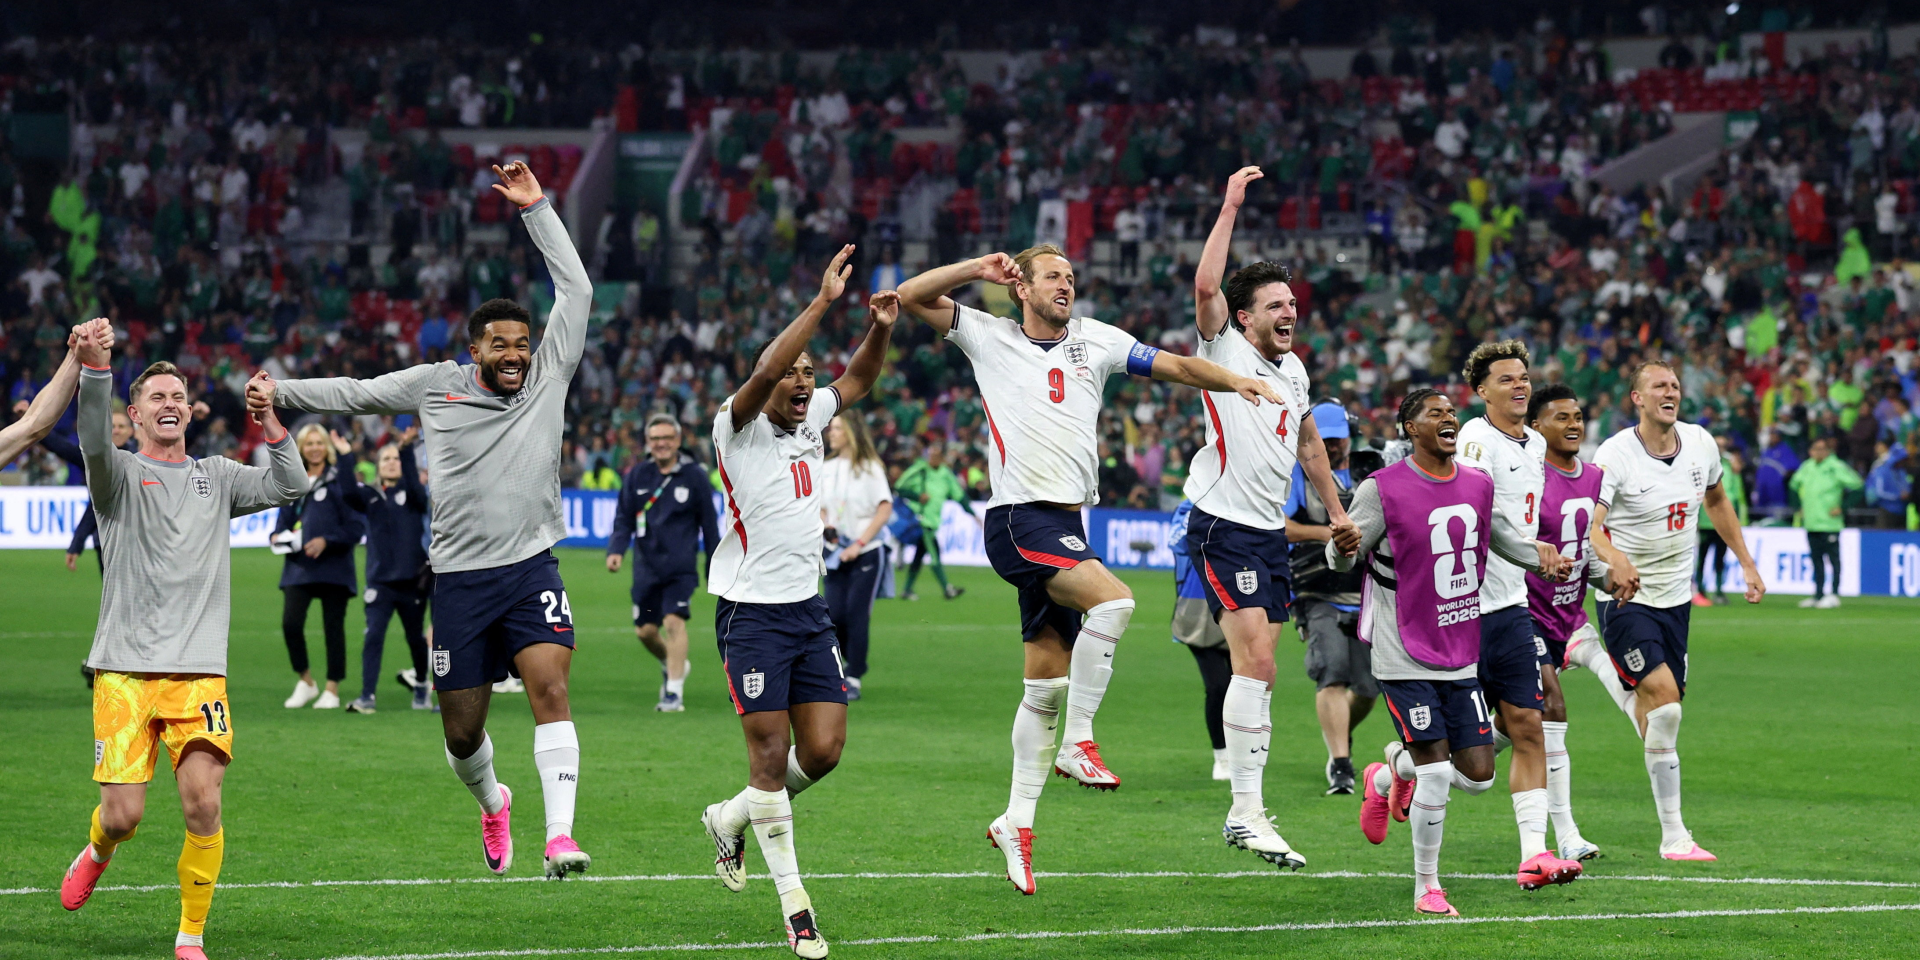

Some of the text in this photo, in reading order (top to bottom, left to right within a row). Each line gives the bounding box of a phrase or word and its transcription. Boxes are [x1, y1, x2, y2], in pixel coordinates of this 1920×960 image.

[1048, 367, 1065, 404] 9
[1276, 409, 1289, 443] 4
[790, 460, 812, 499] 10
[1525, 492, 1535, 524] 3
[1668, 502, 1689, 531] 15
[1777, 552, 1816, 582] FIF
[1889, 543, 1920, 597] FO
[1450, 577, 1468, 590] FIFA
[540, 590, 573, 625] 24
[1436, 596, 1480, 613] WORLD CUP
[1437, 606, 1480, 627] 2026
[831, 645, 845, 679] 1
[200, 700, 228, 733] 13
[558, 773, 577, 782] ENG
